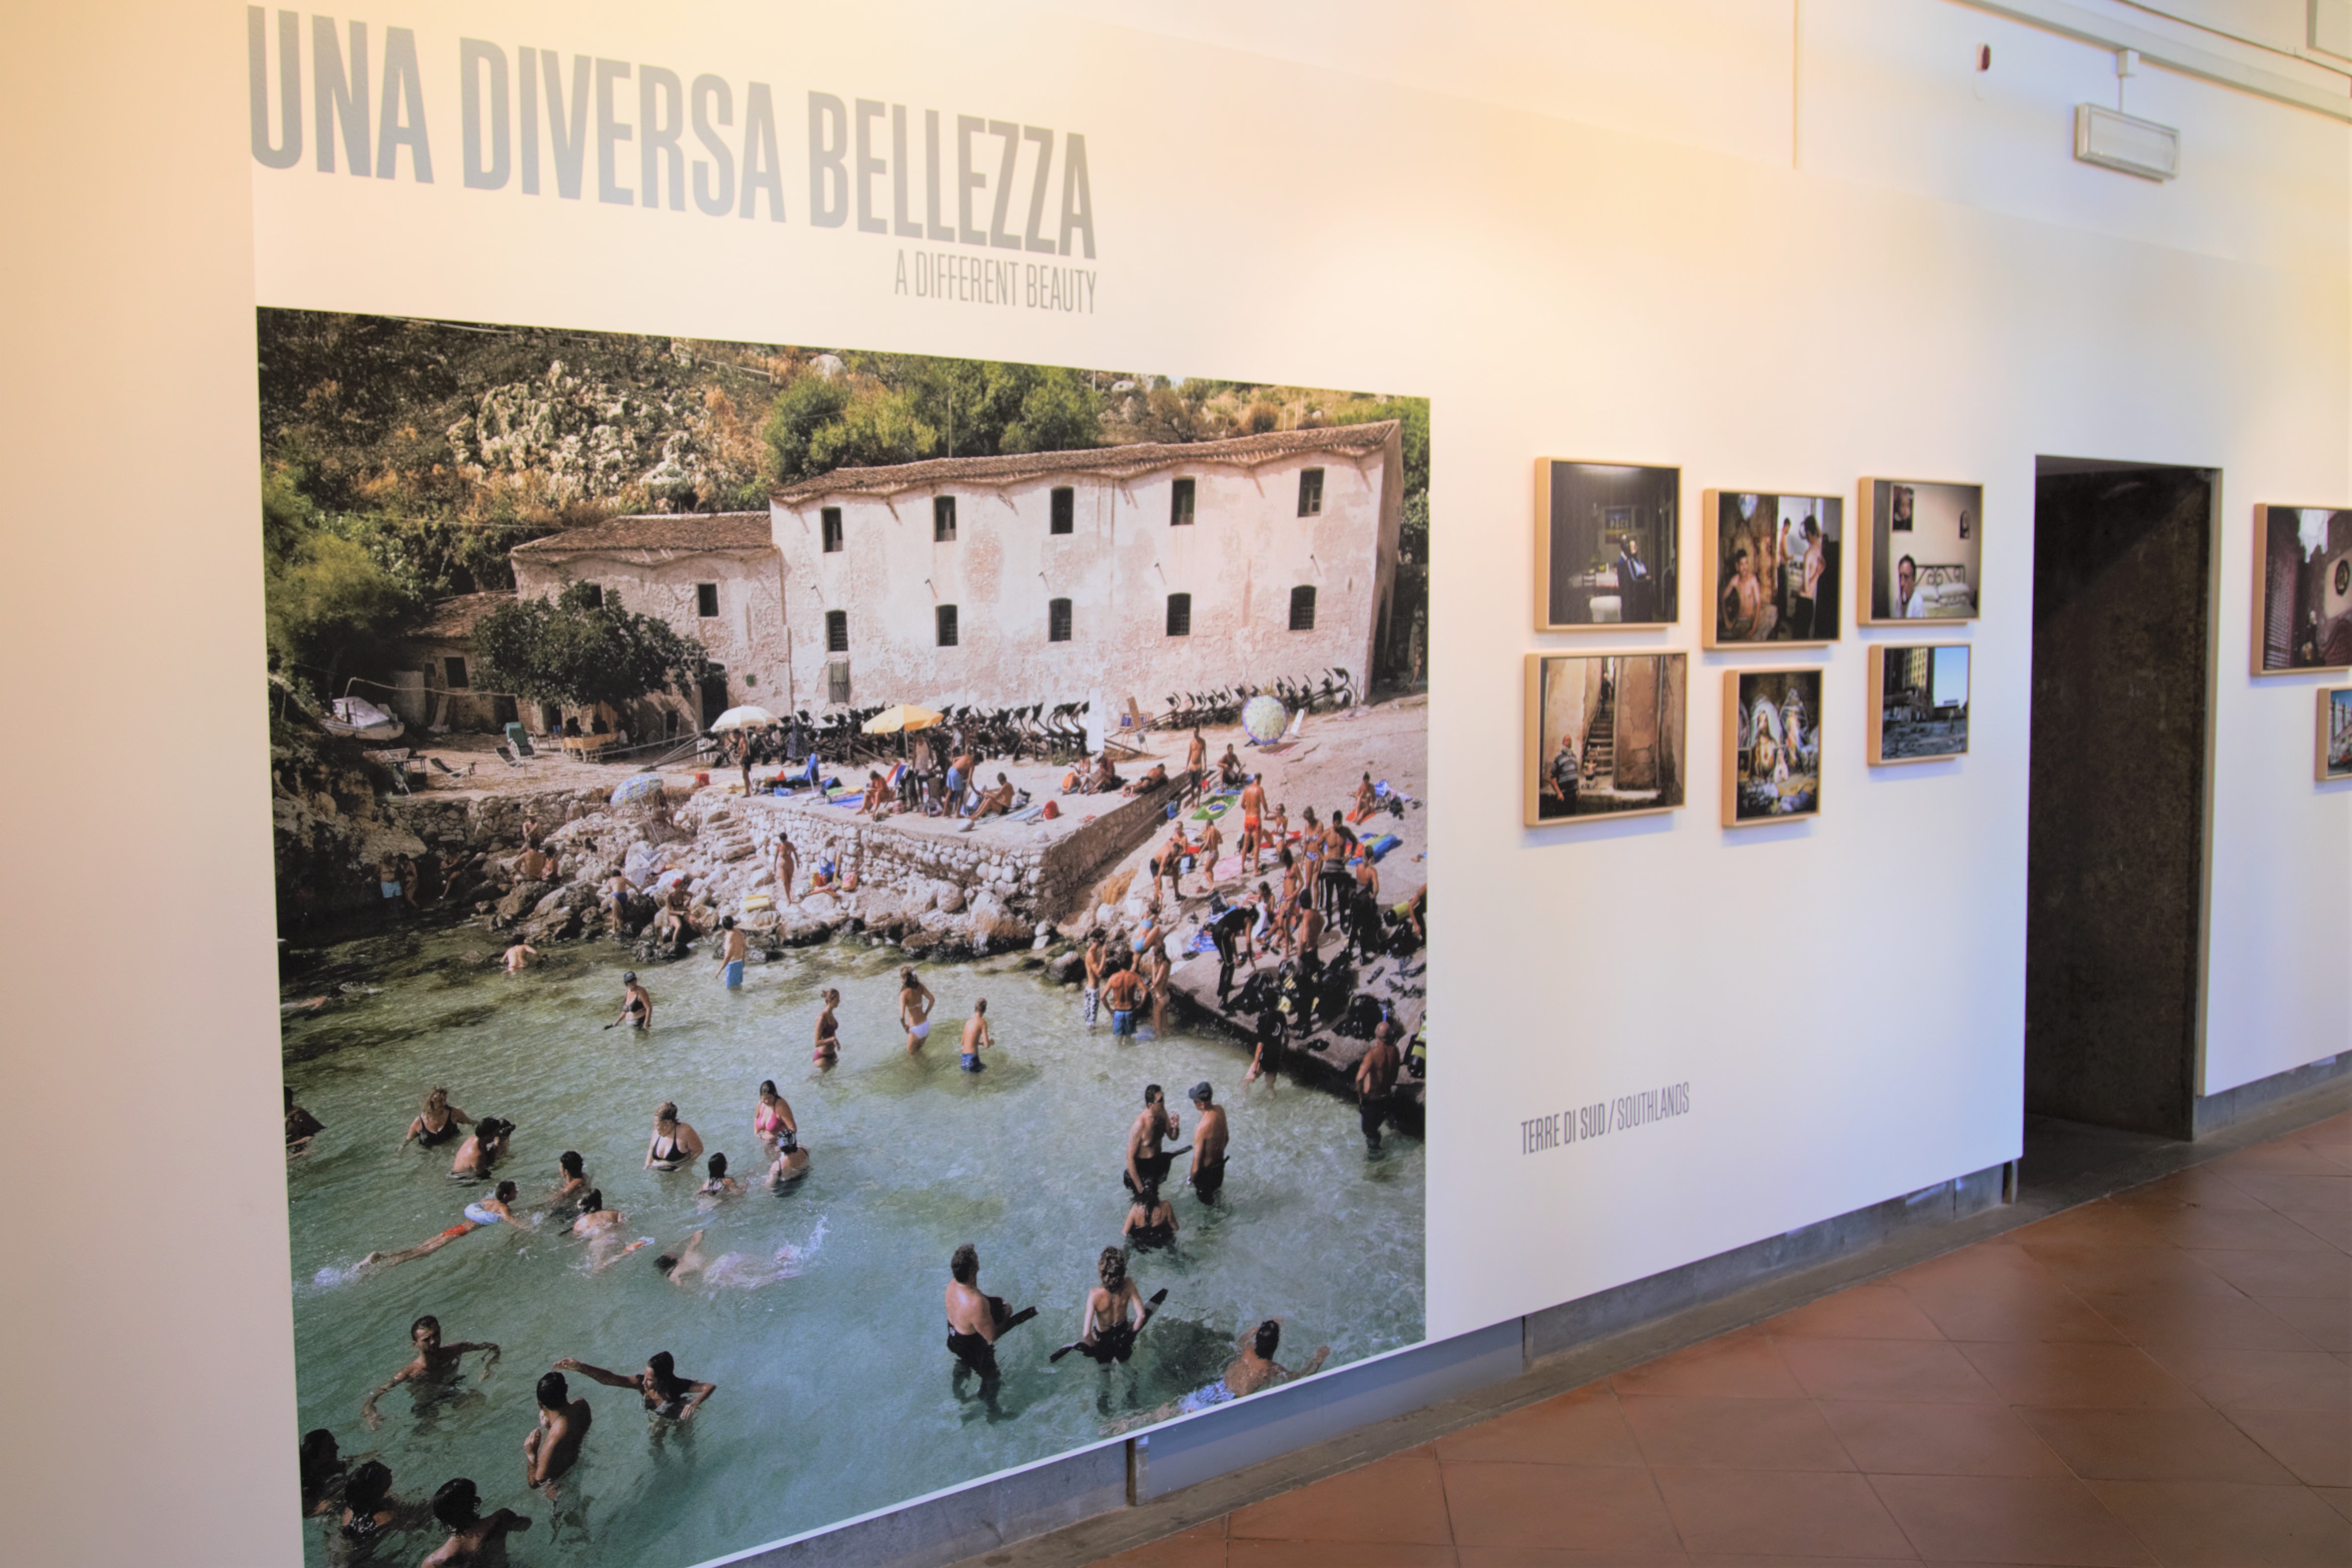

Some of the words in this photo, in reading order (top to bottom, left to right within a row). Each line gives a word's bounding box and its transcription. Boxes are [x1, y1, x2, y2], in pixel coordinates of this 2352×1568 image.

[247, 4, 434, 184] UNA
[459, 36, 786, 223] DIVERSA
[807, 90, 1096, 259] BELLEZZA
[895, 249, 908, 295] A
[915, 250, 1019, 307] DIFFERENT
[1026, 263, 1096, 314] BEAUTY
[1520, 1114, 1560, 1155] TERRE
[1564, 1109, 1576, 1145] DI
[1581, 1103, 1605, 1140] SUD
[1617, 1081, 1689, 1131] SOUTHLANDS
